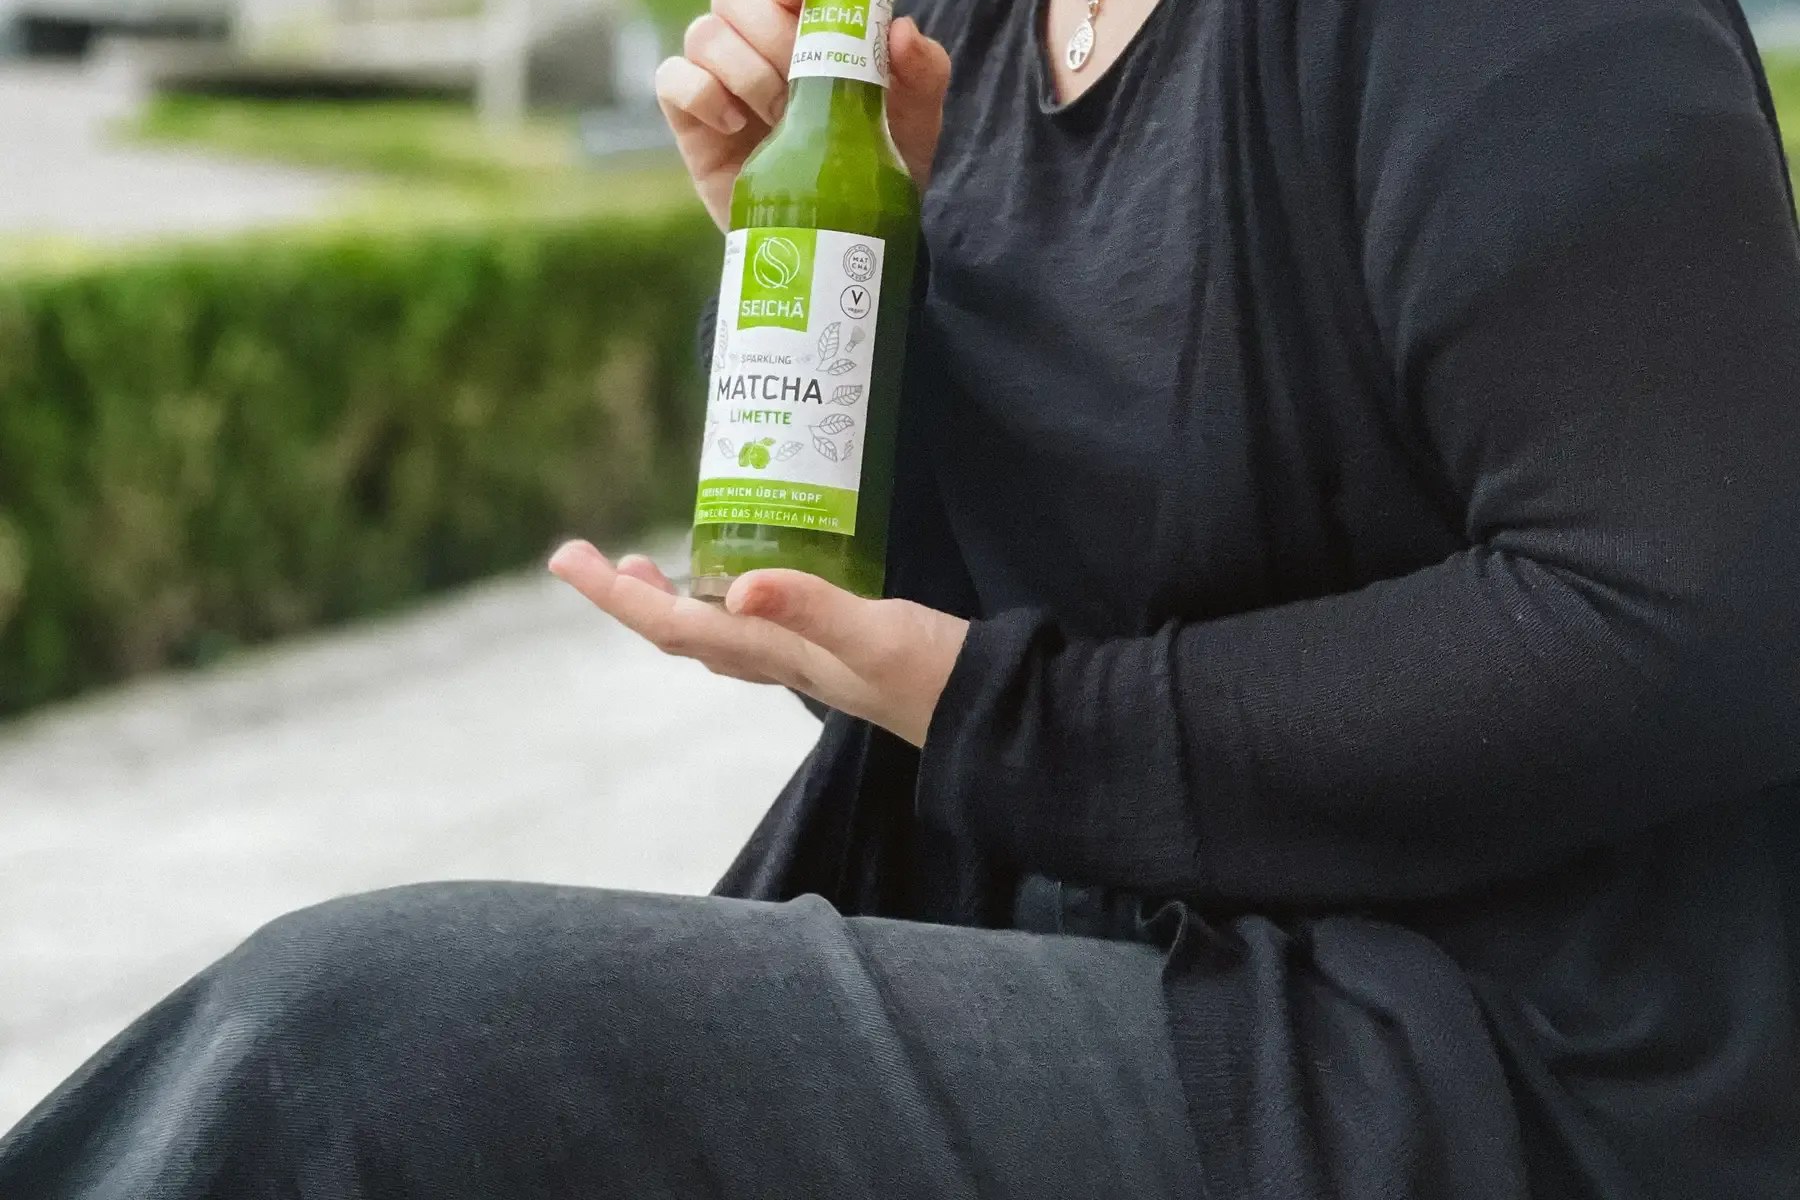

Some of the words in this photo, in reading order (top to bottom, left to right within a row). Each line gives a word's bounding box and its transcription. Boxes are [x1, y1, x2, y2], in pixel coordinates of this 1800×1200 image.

[793, 51, 822, 65] CLEAN
[826, 51, 868, 67] FOCUS
[741, 296, 805, 318] SEICHĀ
[741, 354, 792, 365] SPARKLING
[717, 375, 823, 404] MATCHA
[730, 409, 793, 425] LIMETTE
[727, 487, 752, 498] MICH
[756, 486, 787, 500] ÜBER
[791, 491, 823, 504] KOPF
[731, 508, 751, 519] DAS
[754, 510, 799, 522] MATCHA
[803, 513, 815, 525] IN
[818, 516, 840, 528] MIR
